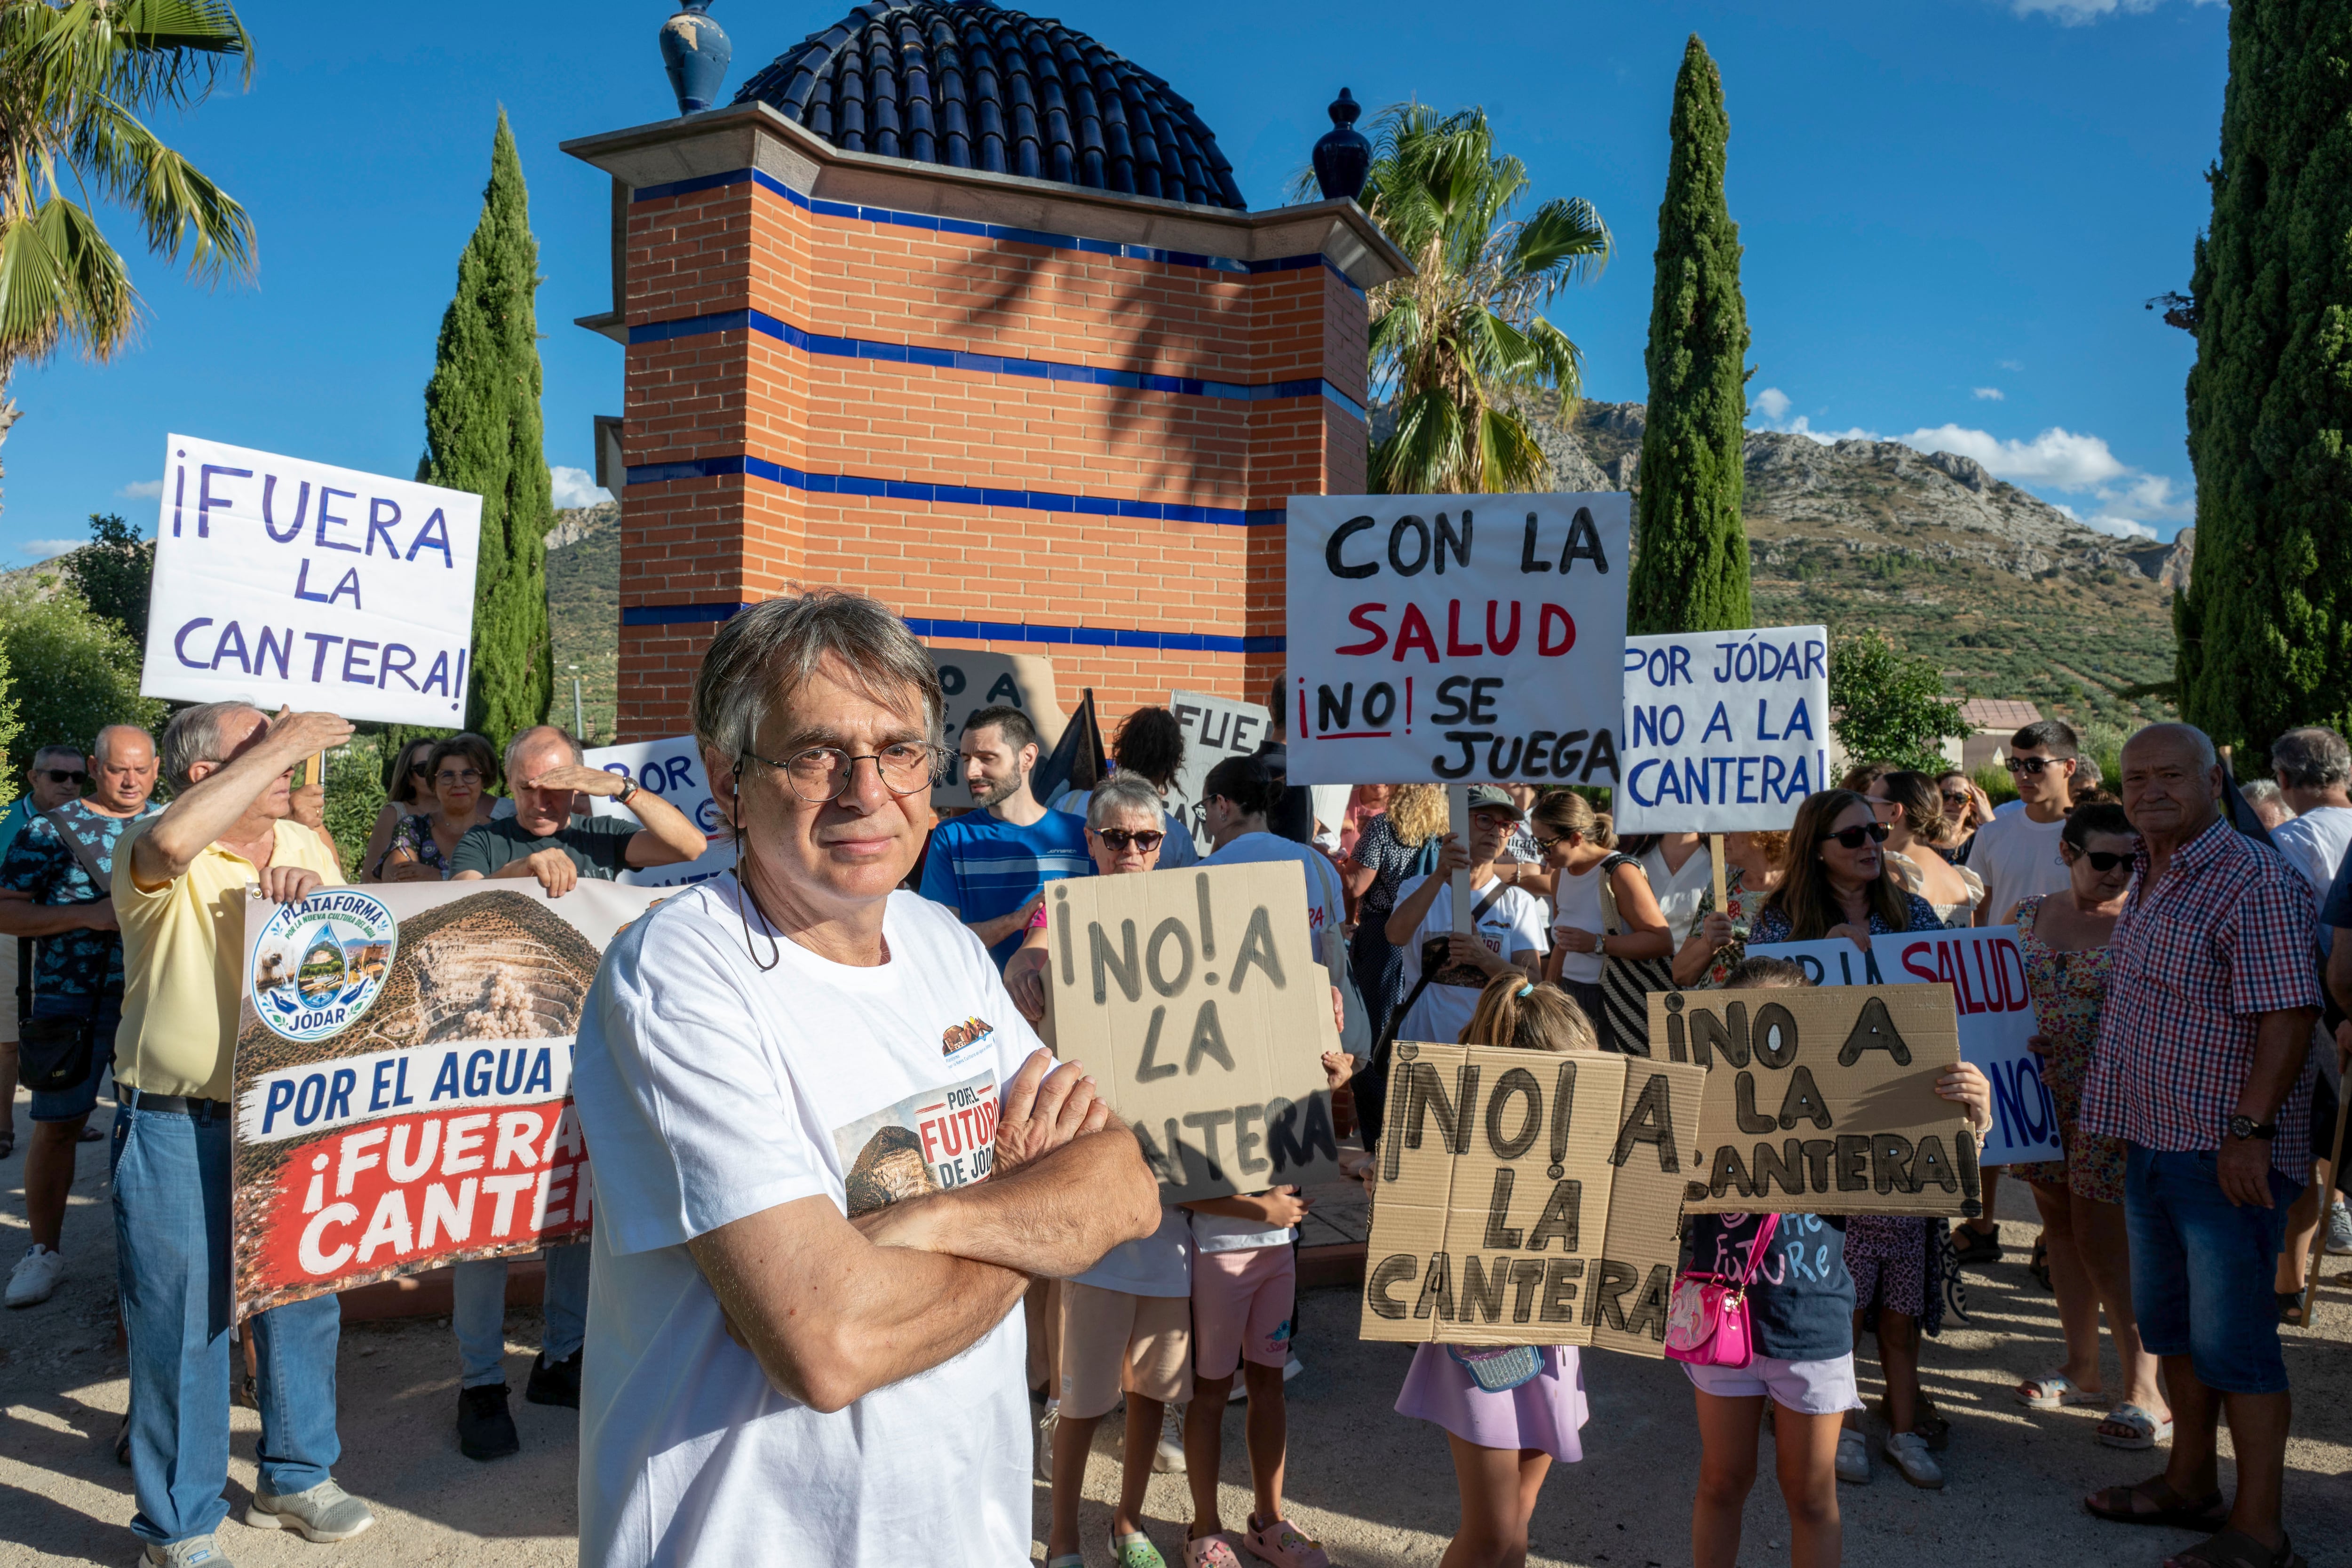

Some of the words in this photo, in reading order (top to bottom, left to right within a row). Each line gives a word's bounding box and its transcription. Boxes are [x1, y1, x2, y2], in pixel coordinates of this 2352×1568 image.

[173, 449, 453, 568] ¡FUERA
[1325, 509, 1473, 579] CON
[1520, 506, 1609, 574] LA
[295, 558, 361, 610] LA
[174, 617, 466, 711] CANTERA!
[1335, 598, 1577, 663] SALUD
[1714, 633, 1826, 683] JÓDAR
[938, 665, 967, 695] O
[986, 673, 1022, 708] A
[1298, 677, 1413, 739] ¡NO!
[1430, 675, 1504, 725] SE
[1700, 700, 1733, 743] A
[1757, 697, 1814, 741] LA
[1175, 703, 1274, 754] FUE
[1430, 728, 1621, 784] JUEGA
[281, 896, 383, 925] PLATAFORMA
[285, 925, 296, 940] POR
[294, 919, 303, 929] LA
[302, 913, 326, 923] NUEVA
[328, 913, 357, 924] CULTURA
[355, 918, 366, 929] DEL
[363, 924, 376, 939] AGUA
[1054, 871, 1220, 1005] ¡NO!
[1228, 904, 1287, 994] A
[1901, 938, 2029, 1015] SALUD
[288, 1008, 345, 1032] JÓDAR
[1135, 999, 1236, 1083] LA
[1664, 992, 1799, 1075] ¡NO
[1837, 995, 1913, 1067] A
[261, 1068, 357, 1135] POR
[368, 1057, 414, 1112] EL
[429, 1047, 552, 1102] AGUA
[1383, 1040, 1577, 1182] ¡NO!
[1607, 1074, 1680, 1174] A
[1734, 1065, 1833, 1134] LA
[302, 1105, 583, 1214] ¡FUERA
[920, 1097, 1000, 1164] FUTURO
[1133, 1090, 1339, 1186] NTERA
[939, 1158, 968, 1189] DE
[1483, 1167, 1582, 1252] LA
[1367, 1251, 1673, 1345] CANTERA
